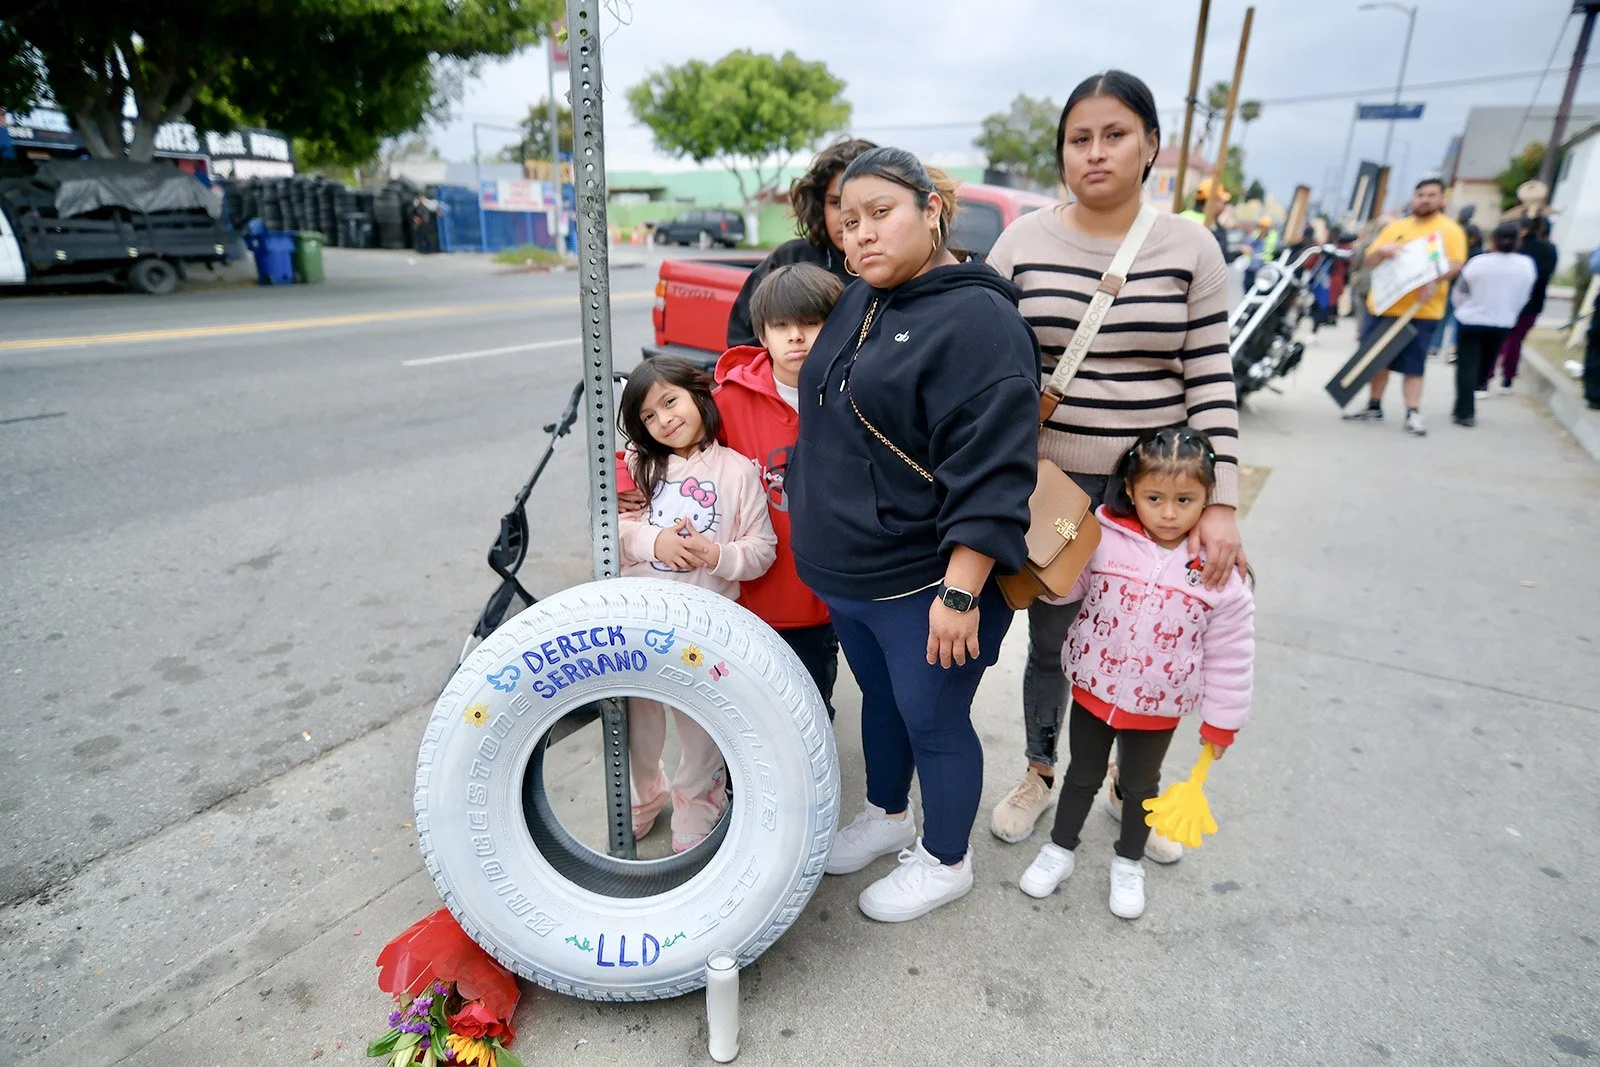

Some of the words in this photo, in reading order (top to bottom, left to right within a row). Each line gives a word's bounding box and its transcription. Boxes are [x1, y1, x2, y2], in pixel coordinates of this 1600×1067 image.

[672, 284, 717, 301] TOYOTA
[1052, 333, 1091, 388] MICHAEL
[1083, 293, 1109, 331] KORS
[522, 625, 626, 674] DERICK
[532, 650, 648, 699] SERRANO
[466, 691, 563, 938] BRIDGESTONE
[596, 932, 661, 968] LLD
